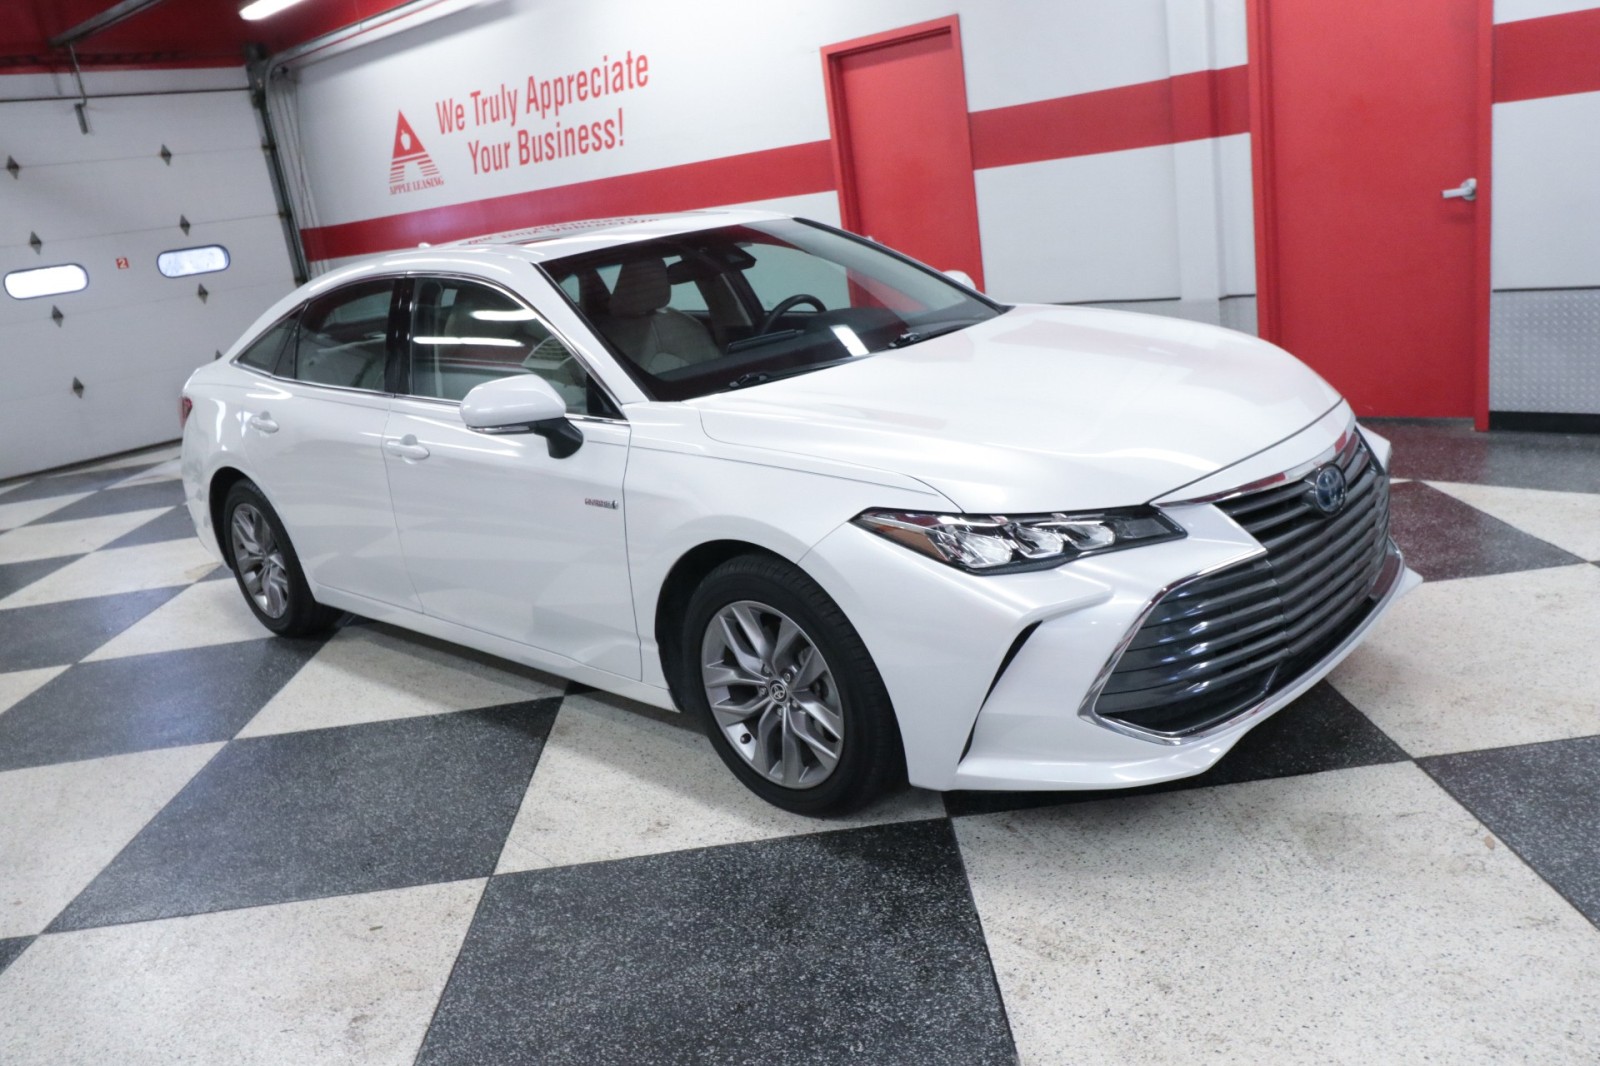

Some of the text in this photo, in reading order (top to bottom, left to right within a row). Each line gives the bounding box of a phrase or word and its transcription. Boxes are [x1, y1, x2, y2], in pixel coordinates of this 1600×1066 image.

[436, 50, 649, 135] We Truly Appreciate
[468, 107, 625, 175] Your Business!
[389, 176, 445, 195] APPLE LEASING
[118, 257, 127, 269] 2
